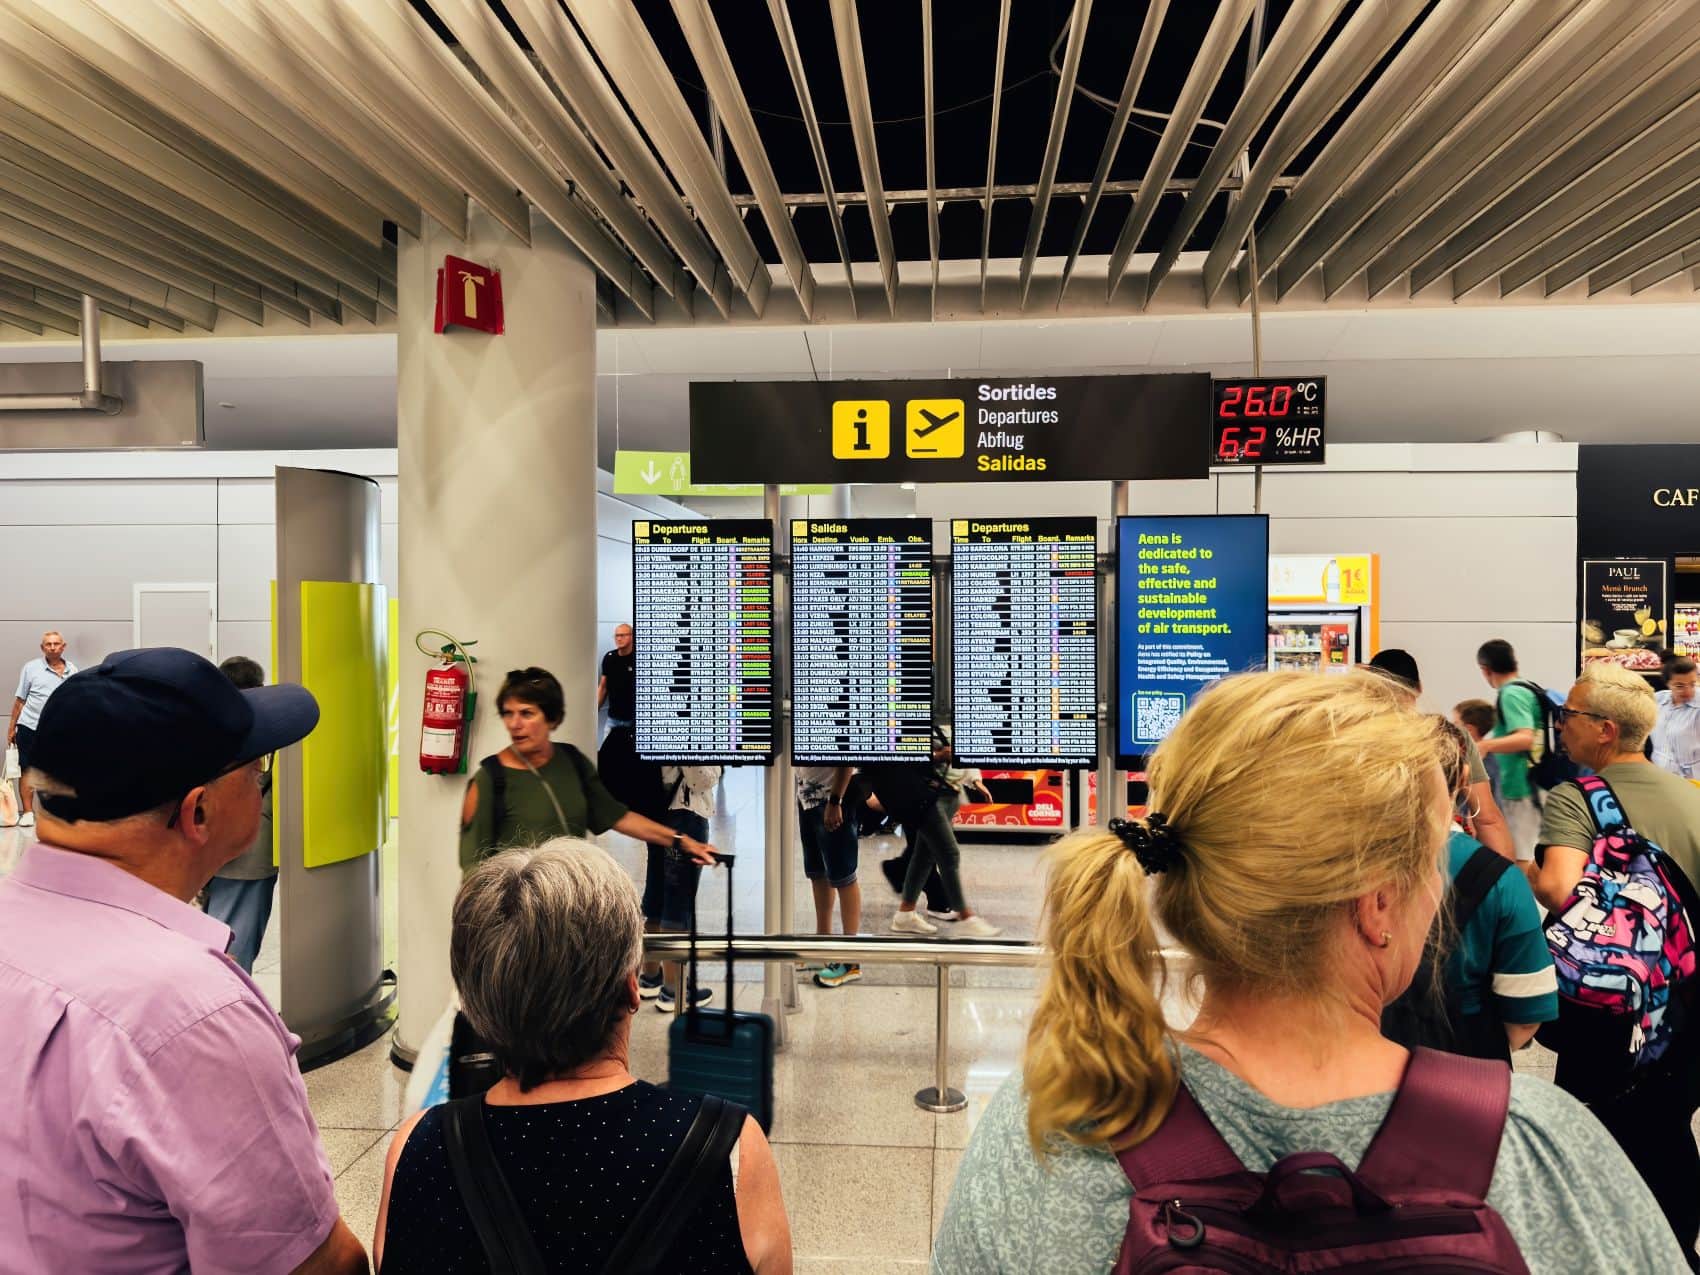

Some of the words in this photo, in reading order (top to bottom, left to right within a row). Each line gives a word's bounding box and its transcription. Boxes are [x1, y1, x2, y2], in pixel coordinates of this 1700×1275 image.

[978, 384, 1057, 402] Sortides
[978, 407, 1058, 426] Departures
[977, 431, 1024, 450] Abflug
[1218, 426, 1266, 456] 62
[1276, 427, 1321, 447] %HR
[977, 454, 1046, 472] Salidas
[652, 524, 708, 535] Departures
[811, 524, 848, 533] Salidas
[971, 523, 1029, 534] Departures
[1138, 534, 1168, 545] Aena
[1171, 533, 1182, 544] is
[1138, 548, 1197, 559] dedicated
[1200, 549, 1213, 559] to
[1138, 563, 1158, 574] the
[1161, 563, 1190, 575] safe,
[1609, 568, 1640, 577] PAUL
[1138, 578, 1191, 589] effective
[1194, 578, 1216, 589] and
[1138, 593, 1207, 604] sustainable
[1138, 608, 1216, 620] development
[1138, 623, 1150, 634] of
[1154, 623, 1169, 634] air
[1172, 623, 1231, 636] transport.
